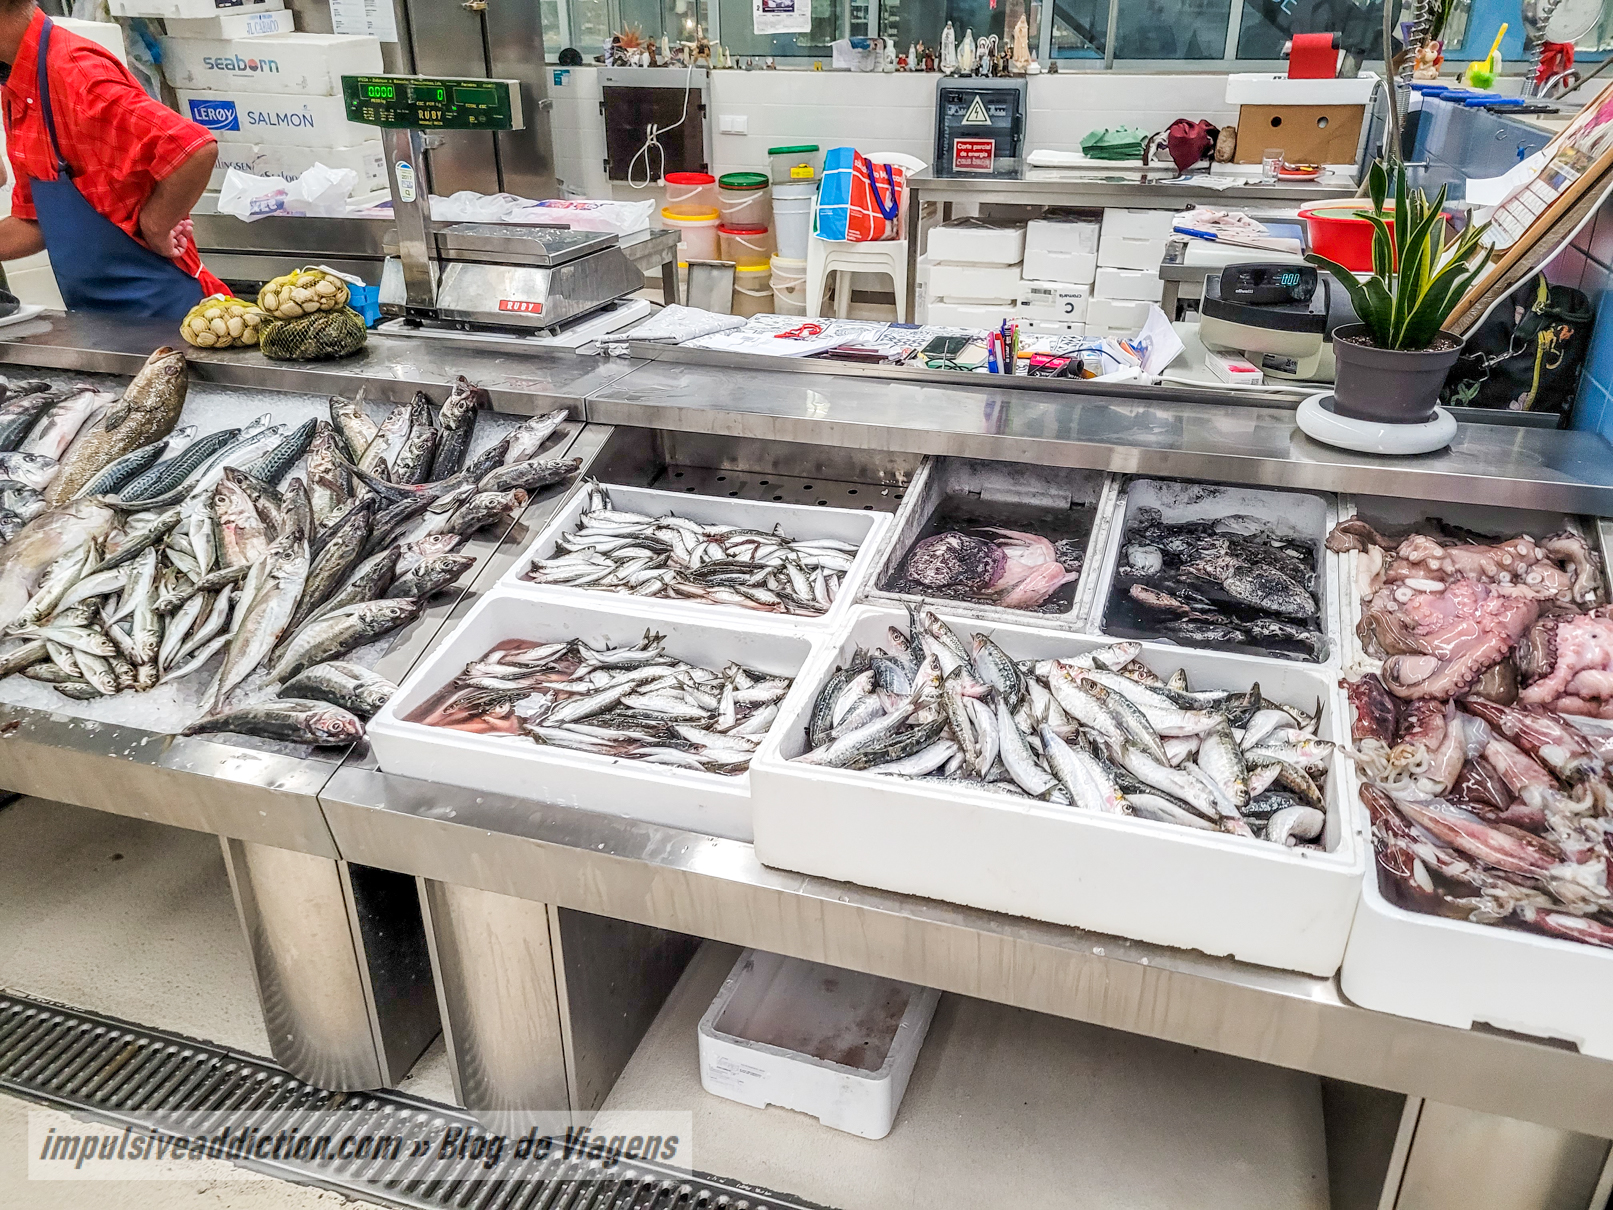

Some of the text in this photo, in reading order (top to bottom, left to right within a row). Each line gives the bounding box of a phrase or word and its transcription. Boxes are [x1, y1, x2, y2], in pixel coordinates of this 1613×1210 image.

[203, 53, 280, 73] seaborn
[194, 107, 232, 121] LERØY
[247, 111, 314, 128] SALMON
[418, 110, 442, 119] RUBY
[973, 143, 992, 151] parcial
[506, 301, 534, 311] RUBY
